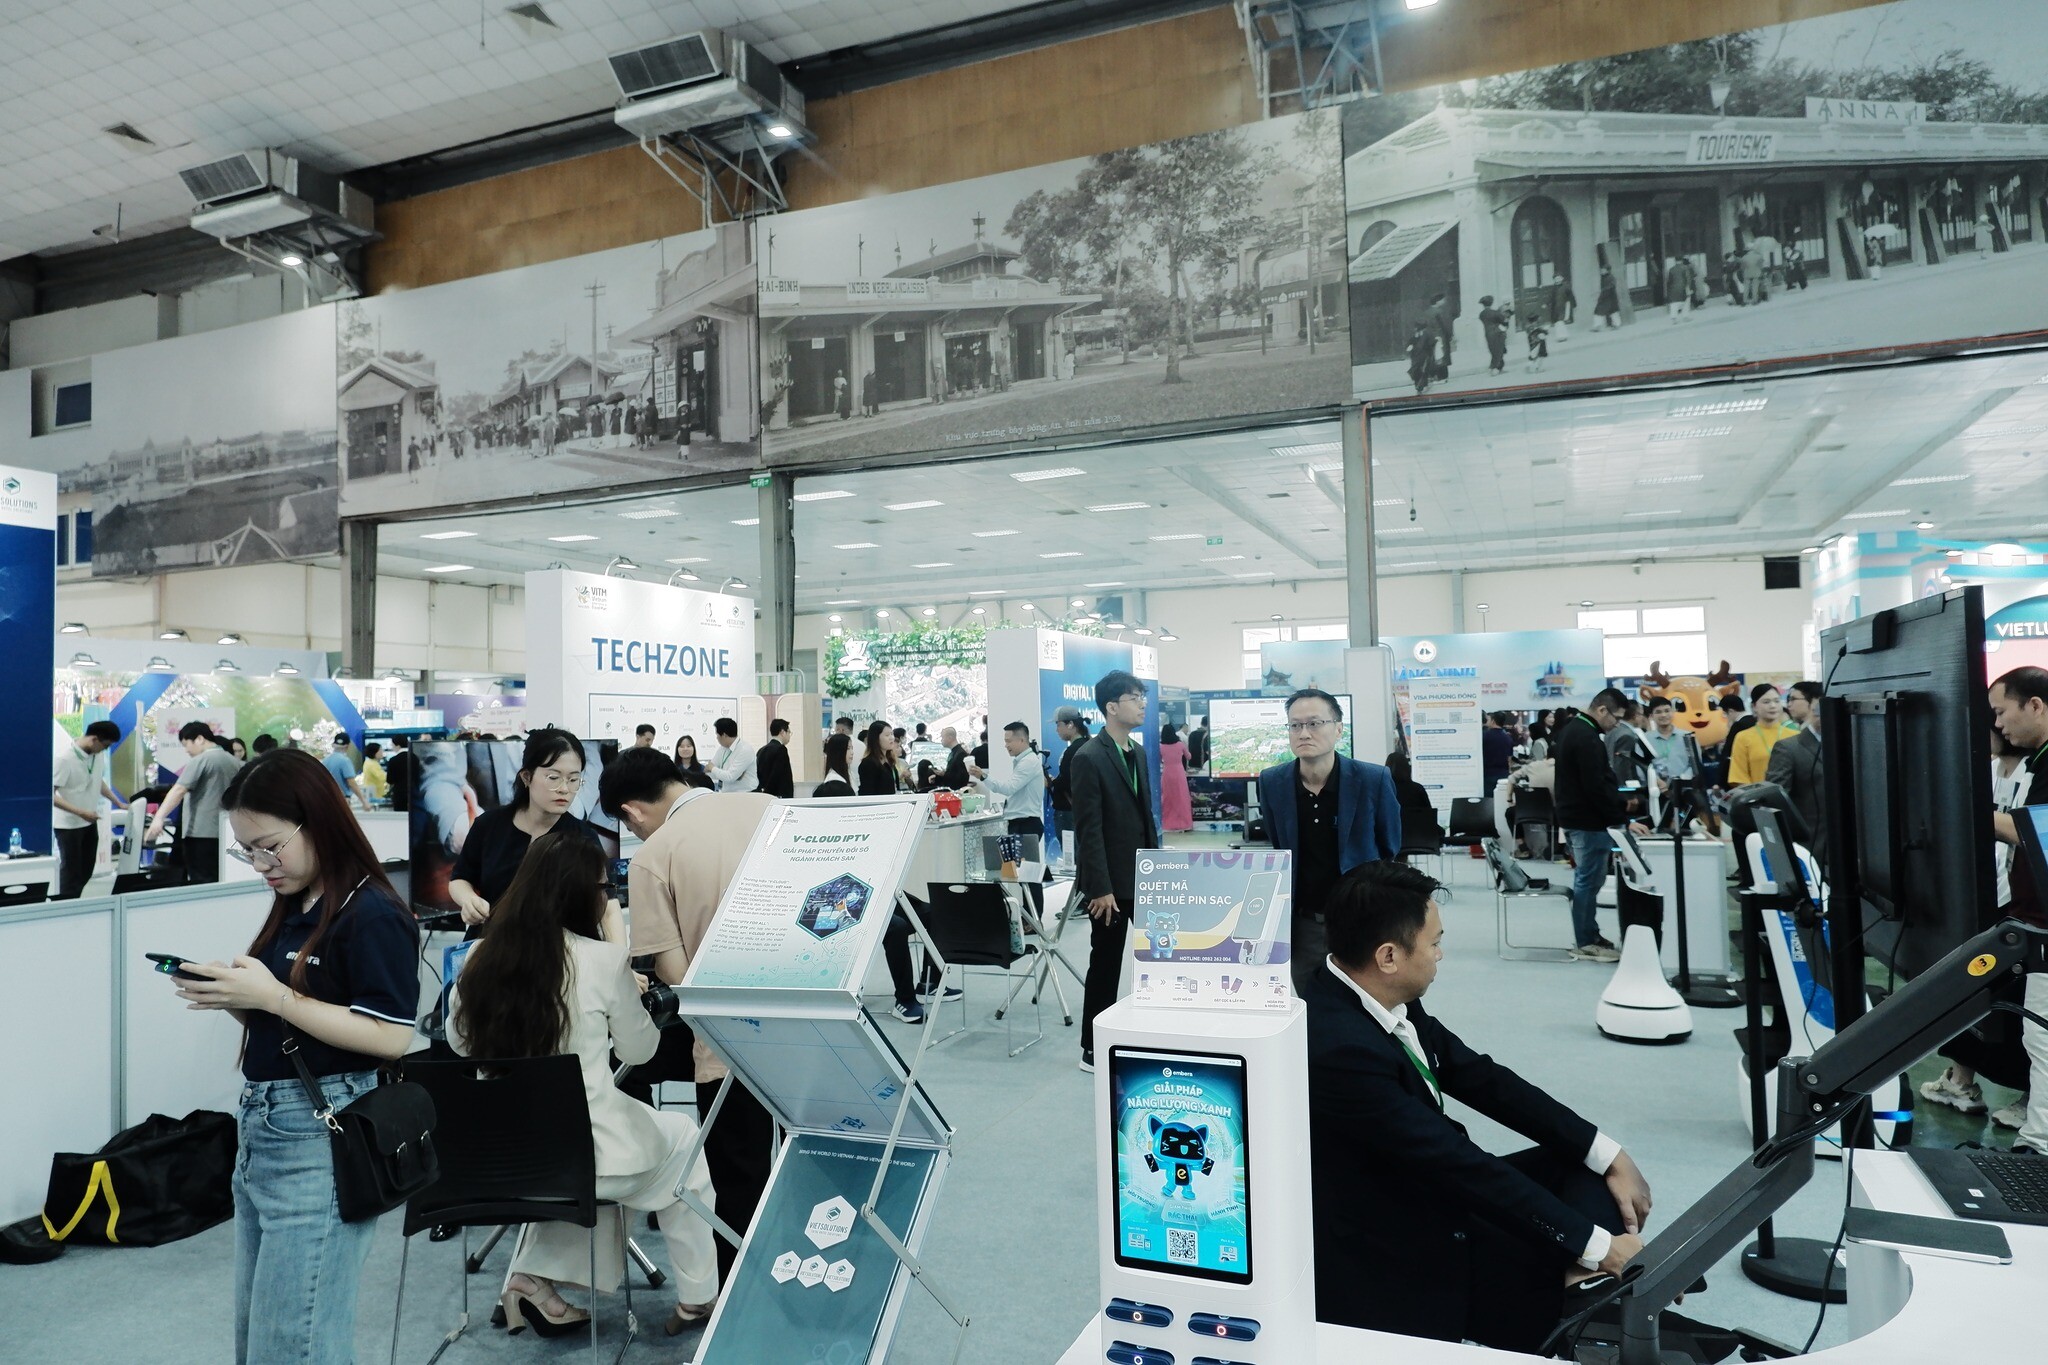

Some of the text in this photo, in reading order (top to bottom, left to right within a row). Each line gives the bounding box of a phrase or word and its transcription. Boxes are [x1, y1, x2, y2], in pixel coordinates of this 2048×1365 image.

[1696, 134, 1773, 161] TOURISME
[848, 281, 871, 295] INDES
[591, 637, 730, 679] TECHZONE
[962, 651, 975, 659] AND
[1063, 684, 1091, 701] DIGITAL
[793, 833, 871, 844] V-CLOUD IPTV
[797, 846, 816, 854] PHÁP
[790, 854, 815, 862] NGÀNH
[815, 854, 840, 862] KHÁCH
[1155, 862, 1189, 871] embera
[1138, 879, 1189, 892] QUÉT MÃ
[1138, 891, 1232, 908] ĐỂ THUÊ PIN SẠC
[1154, 1081, 1203, 1097] GIẢI PHÁP
[1126, 1096, 1157, 1110] NĂNG
[1199, 1103, 1232, 1118] XANH
[809, 1221, 849, 1234] VIETSOLUTIONS
